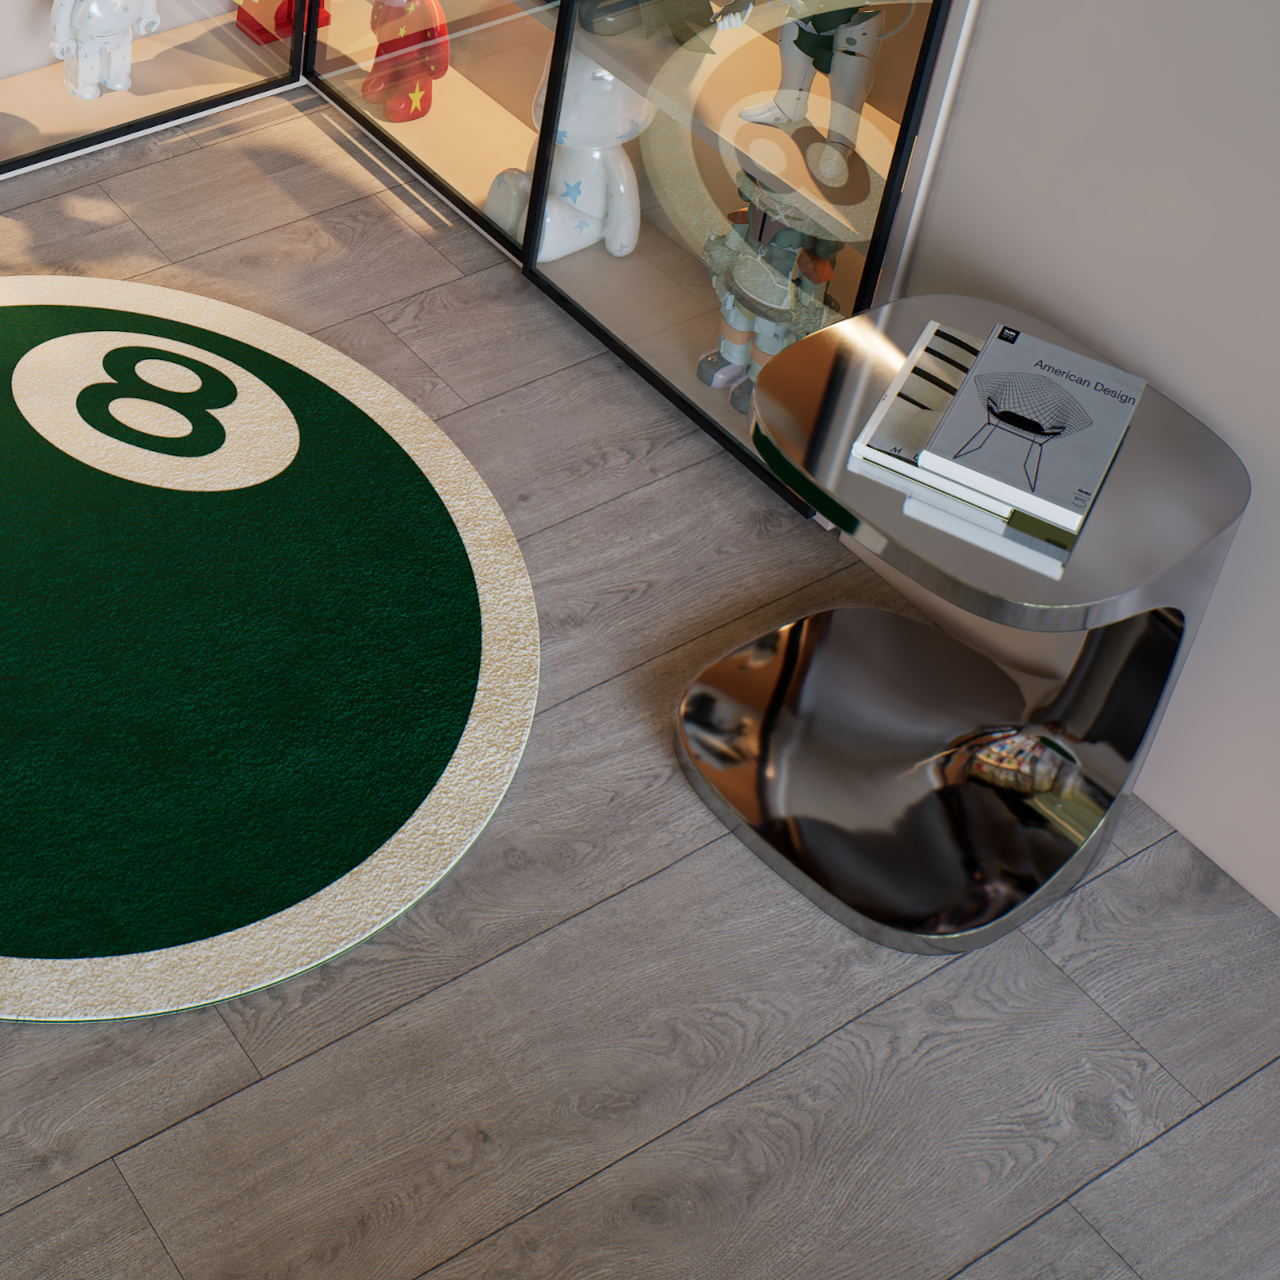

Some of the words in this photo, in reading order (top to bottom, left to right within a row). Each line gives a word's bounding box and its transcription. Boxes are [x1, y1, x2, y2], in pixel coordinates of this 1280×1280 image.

[76, 346, 238, 458] 8
[1033, 359, 1091, 388] American
[1093, 381, 1136, 406] Design
